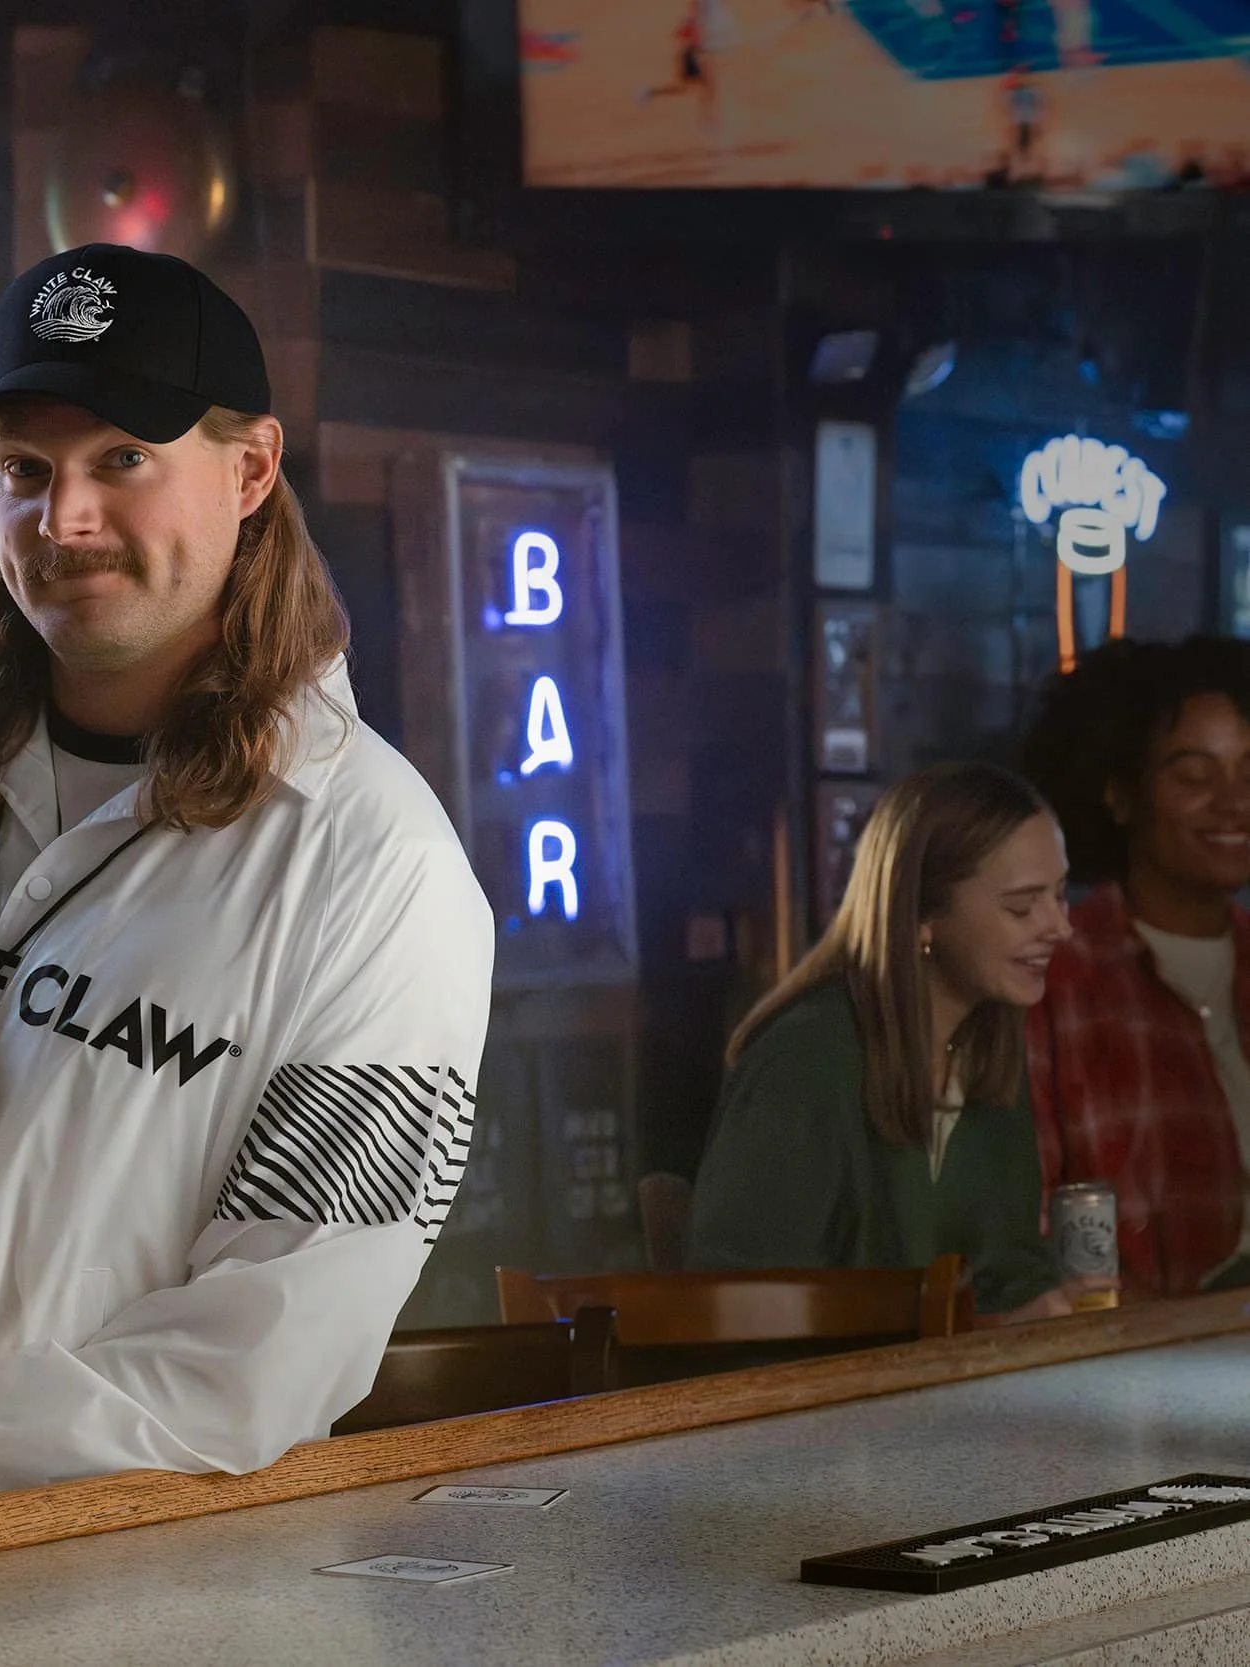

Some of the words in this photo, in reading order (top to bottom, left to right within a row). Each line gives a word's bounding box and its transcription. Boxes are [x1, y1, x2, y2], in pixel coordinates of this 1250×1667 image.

[30, 272, 68, 318] WHITE
[71, 267, 118, 294] CLAW
[504, 531, 579, 921] BAR
